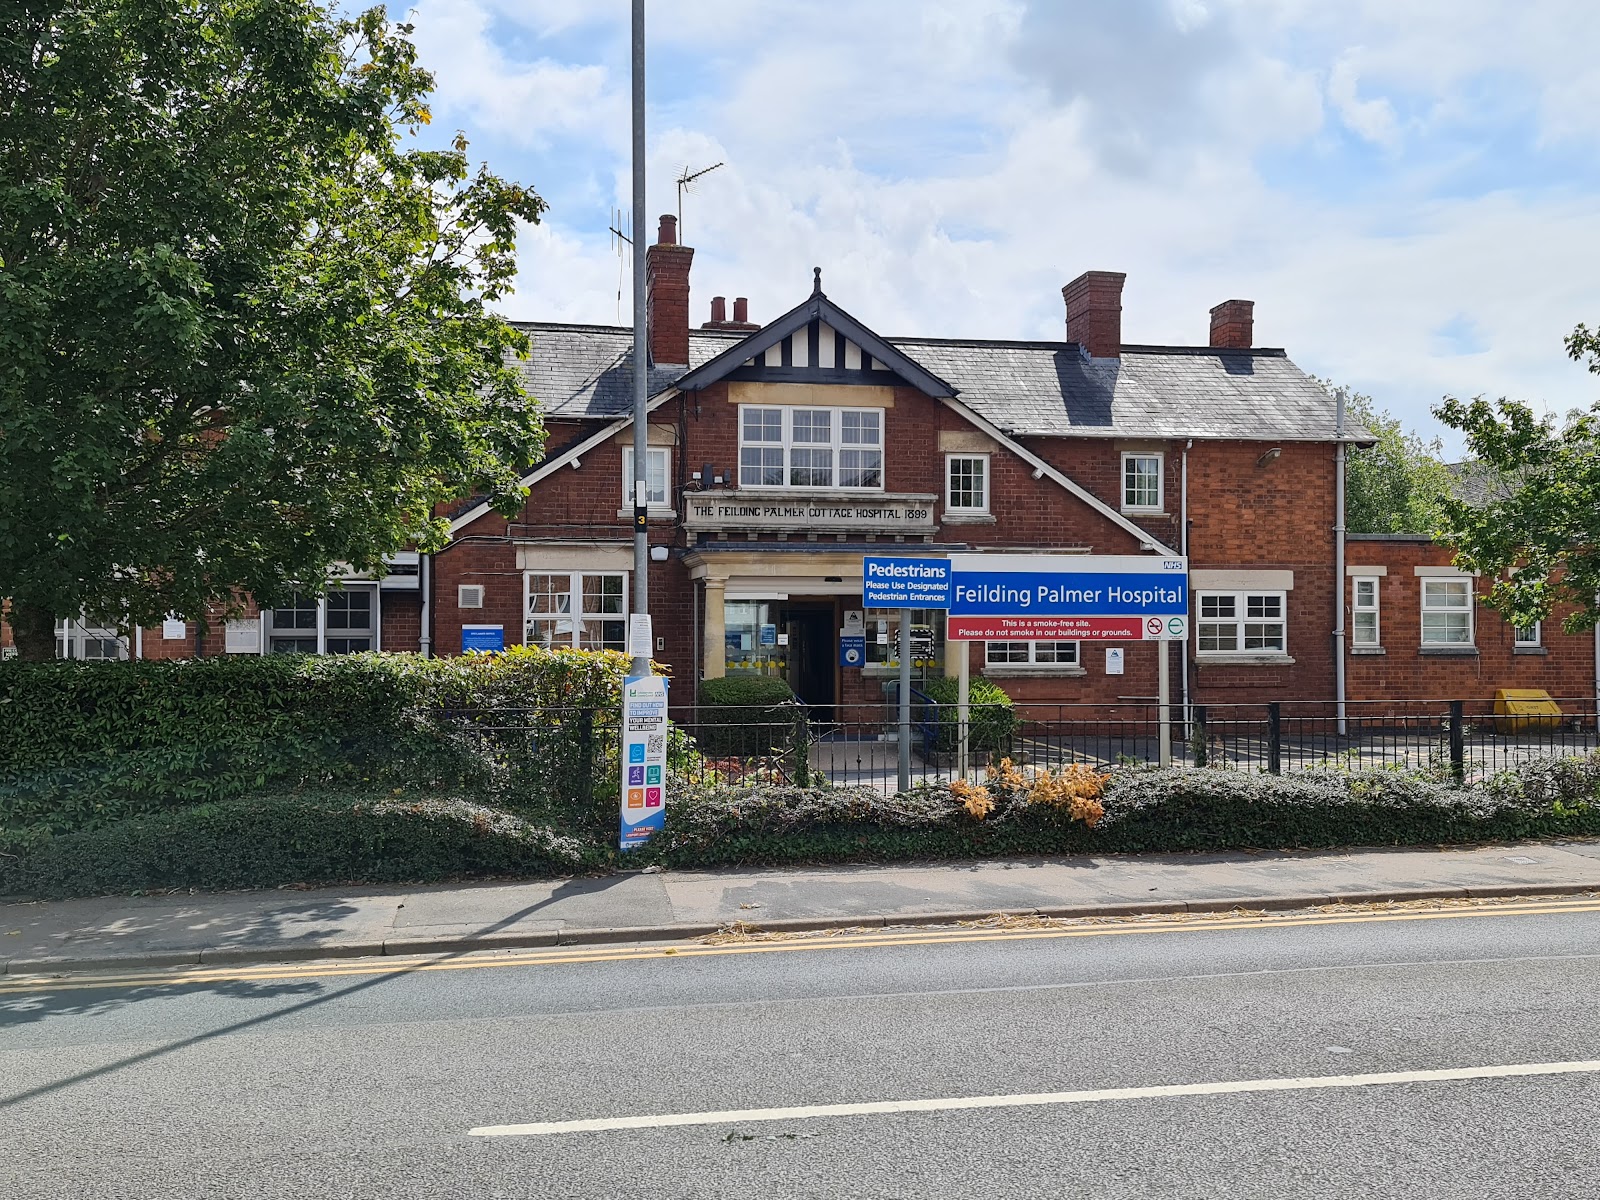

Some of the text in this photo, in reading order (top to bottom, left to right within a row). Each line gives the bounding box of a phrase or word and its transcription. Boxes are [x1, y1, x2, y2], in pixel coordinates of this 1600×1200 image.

[694, 506, 927, 519] THE FEILDING PALMER COTTAGE HOSPITAL 1899
[638, 515, 646, 525] 3
[868, 562, 946, 578] Pedestrians
[1164, 561, 1182, 570] NHS
[865, 580, 949, 591] Please Use Designated
[868, 591, 946, 602] Pedestrian Entrances
[956, 584, 1182, 607] Feilding Palmer Hospital
[1002, 619, 1018, 627] This
[1018, 619, 1026, 627] is
[1033, 619, 1075, 628] smoke-free
[1076, 619, 1091, 627] site.
[958, 628, 983, 636] Please
[985, 628, 995, 636] do
[1010, 628, 1034, 636] smoke
[1036, 628, 1043, 636] in
[1058, 628, 1091, 638] buildings
[1101, 629, 1133, 638] grounds.
